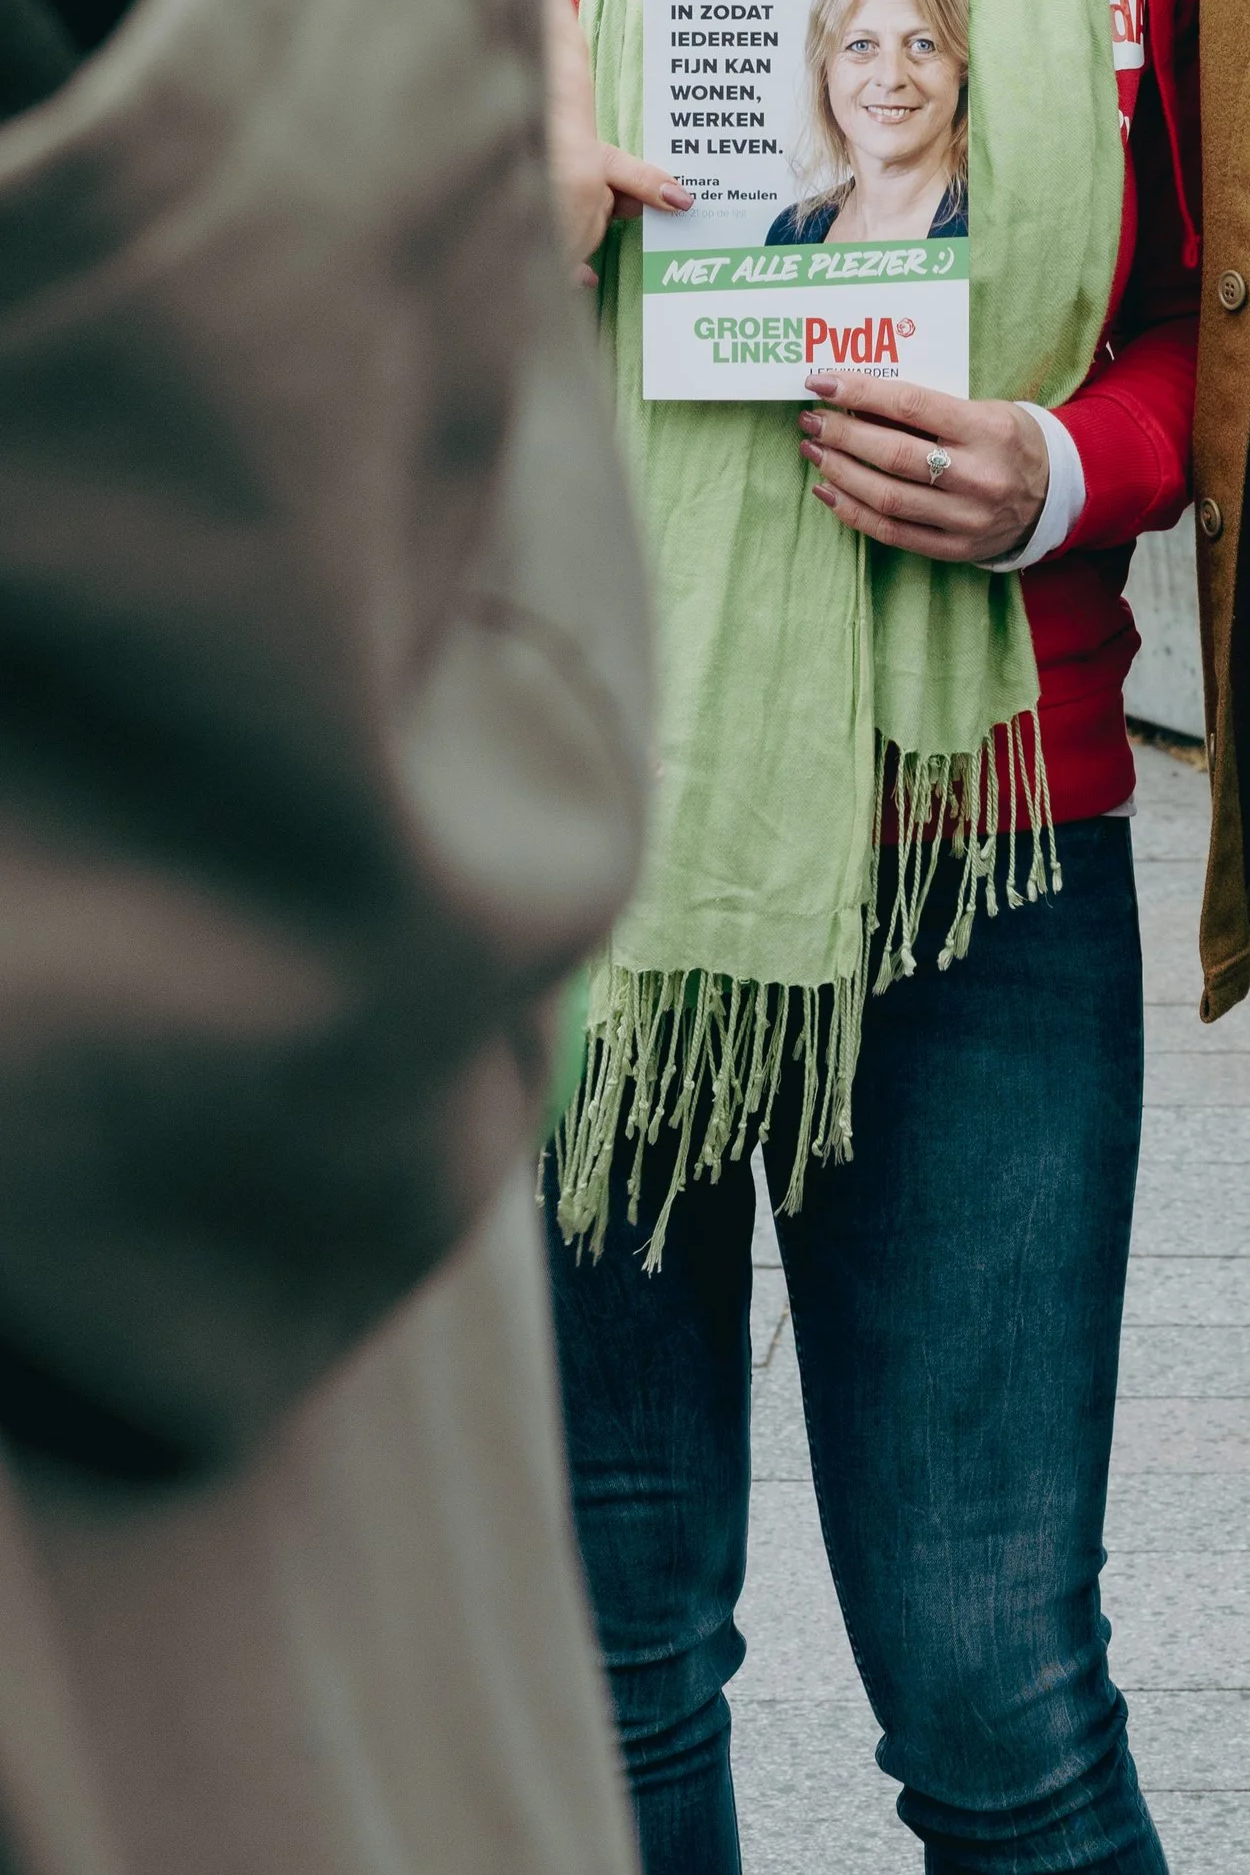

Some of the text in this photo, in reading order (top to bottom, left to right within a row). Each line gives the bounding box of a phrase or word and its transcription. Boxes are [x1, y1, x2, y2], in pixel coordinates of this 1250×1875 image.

[671, 5, 774, 20] IN ZODAT
[671, 31, 779, 47] IEDEREEN
[671, 58, 771, 74] FIJN KAN
[670, 85, 762, 104] WONEN,
[670, 112, 765, 127] WERKEN
[671, 139, 783, 154] EN LEVEN.
[701, 190, 723, 200] der
[727, 189, 778, 201] Meulen
[702, 210, 714, 220] op
[717, 208, 730, 218] de
[662, 257, 731, 287] MET
[731, 253, 802, 284] ALLE
[808, 247, 928, 280] PLEZIER
[693, 317, 899, 364] GROEN PvdA
[713, 341, 804, 364] LINKS
